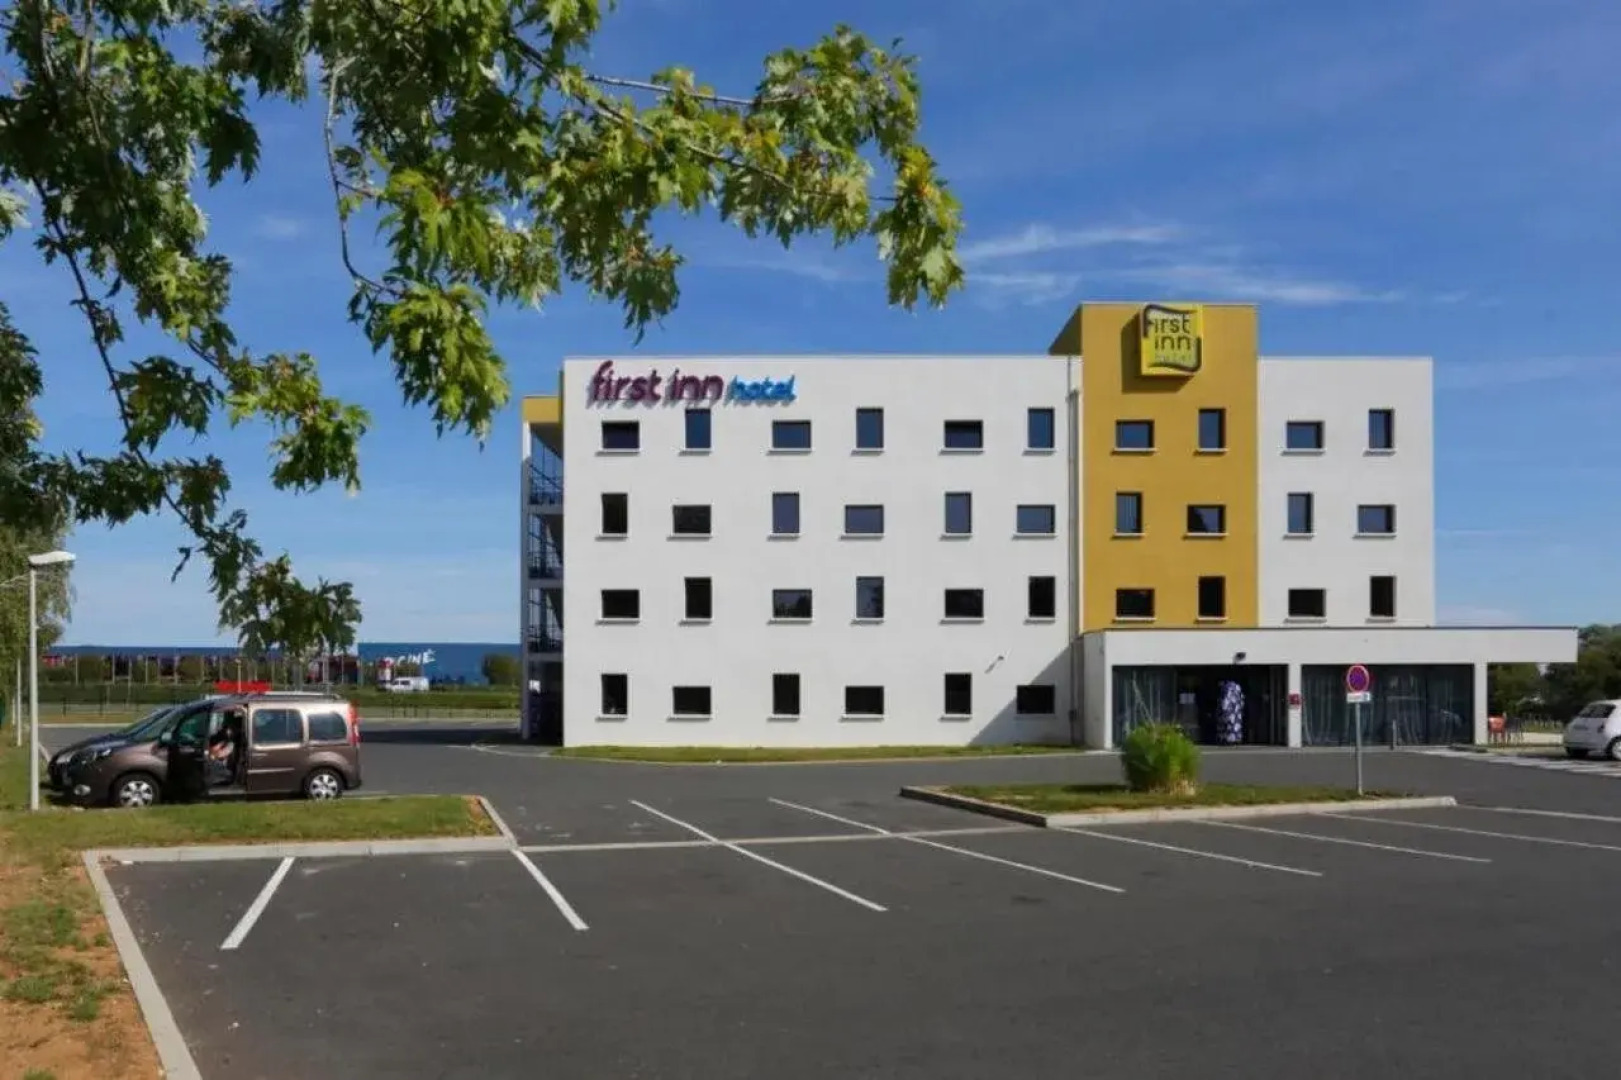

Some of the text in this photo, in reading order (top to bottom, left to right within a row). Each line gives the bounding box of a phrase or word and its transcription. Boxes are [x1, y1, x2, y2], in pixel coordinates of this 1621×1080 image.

[1154, 334, 1191, 350] inn
[591, 360, 796, 402] first inn hotel
